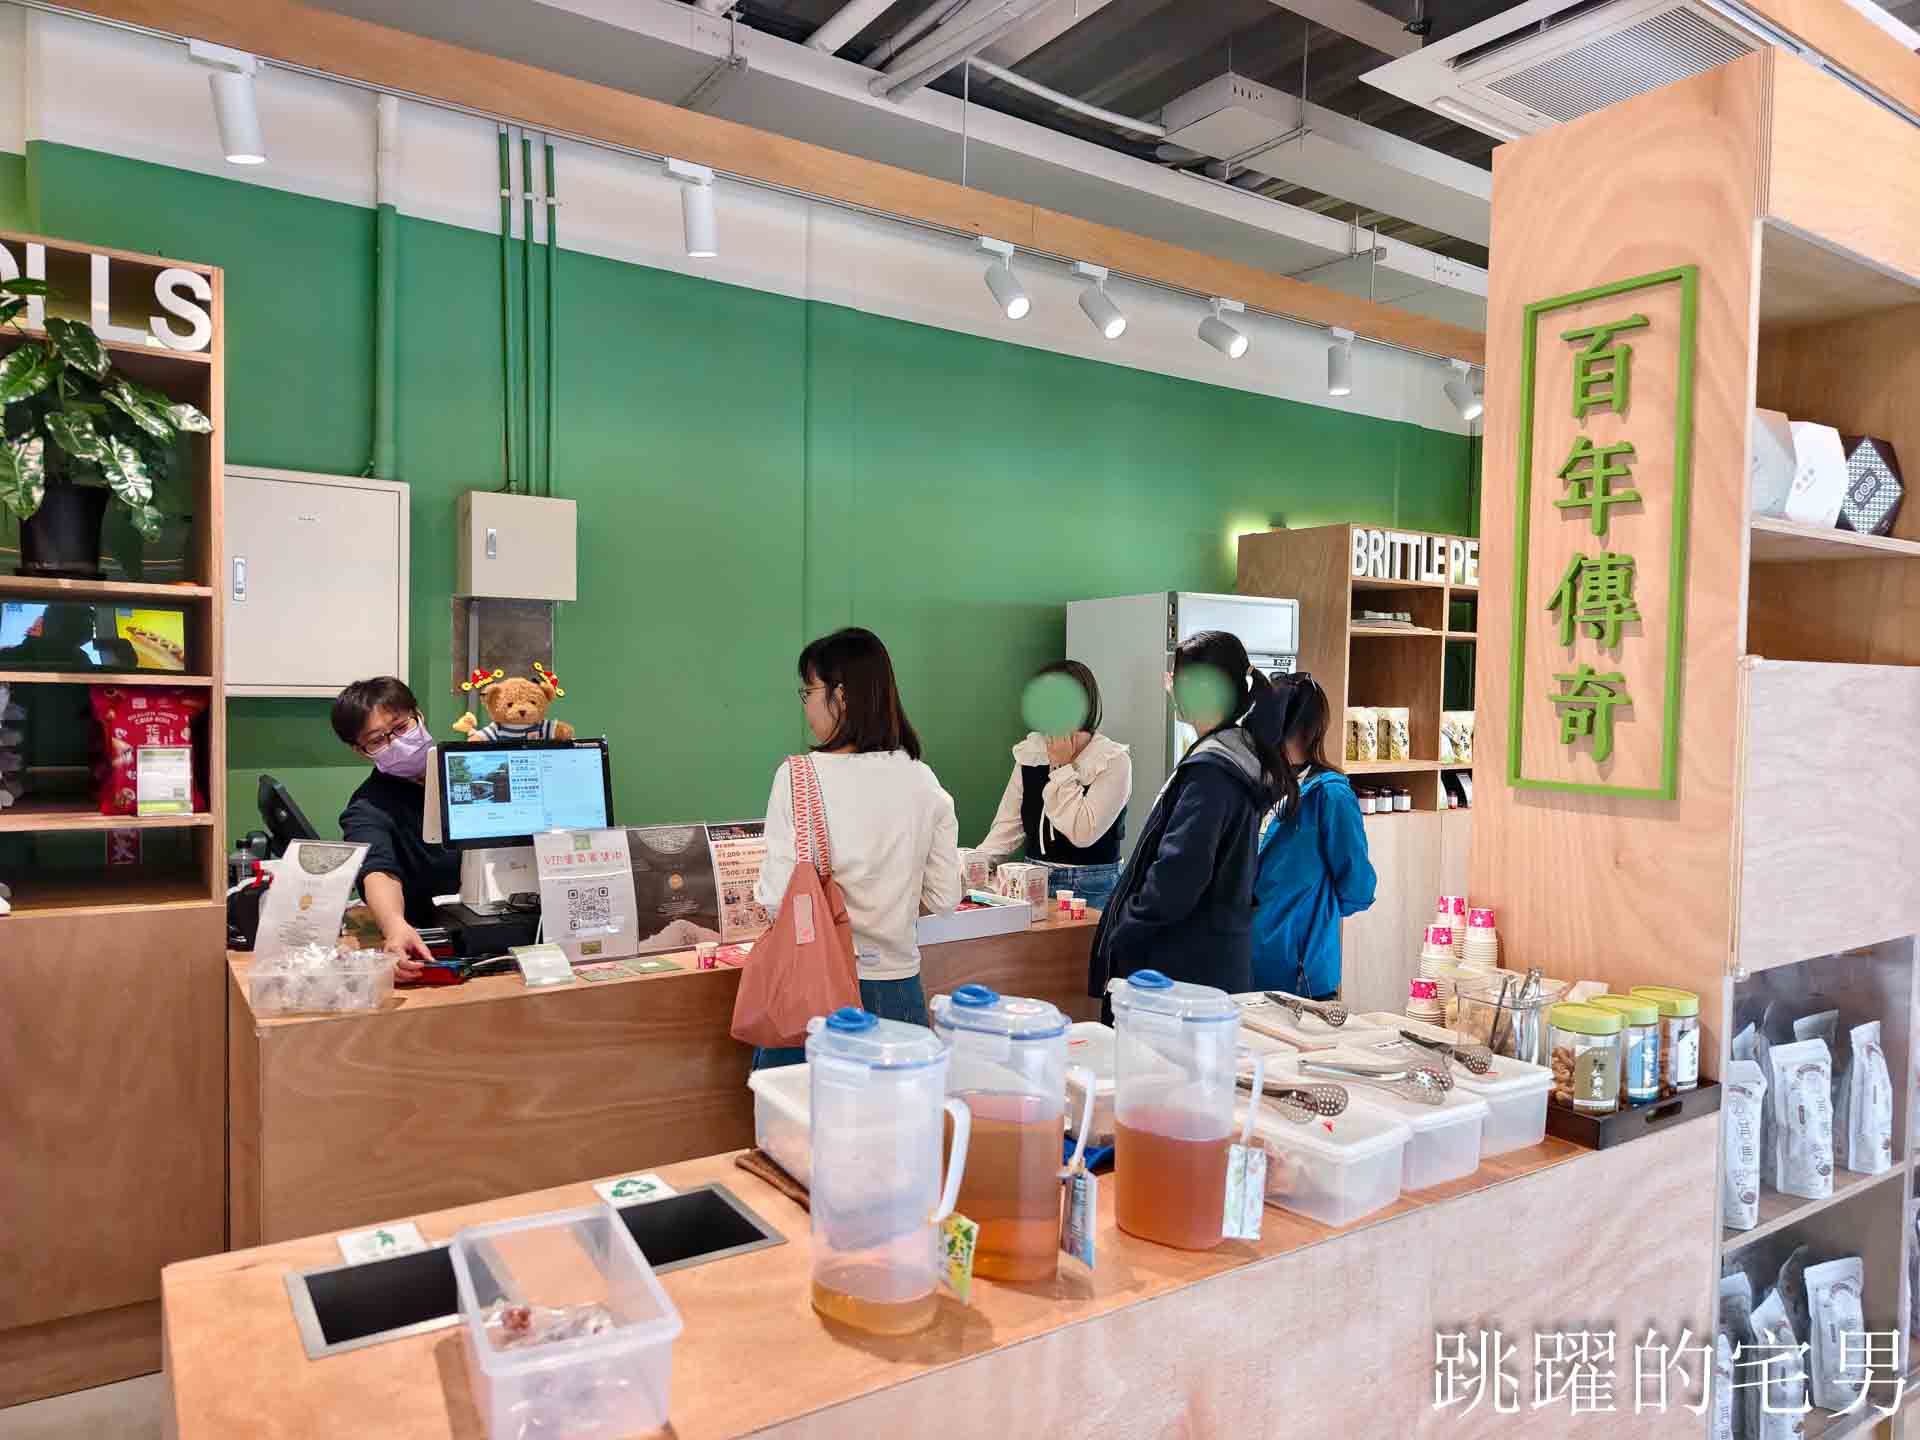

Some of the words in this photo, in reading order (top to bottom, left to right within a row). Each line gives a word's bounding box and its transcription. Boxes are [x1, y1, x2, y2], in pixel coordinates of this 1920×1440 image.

[1351, 528, 1446, 584] BRITTLE
[1546, 313, 1650, 762] 百年傳奇
